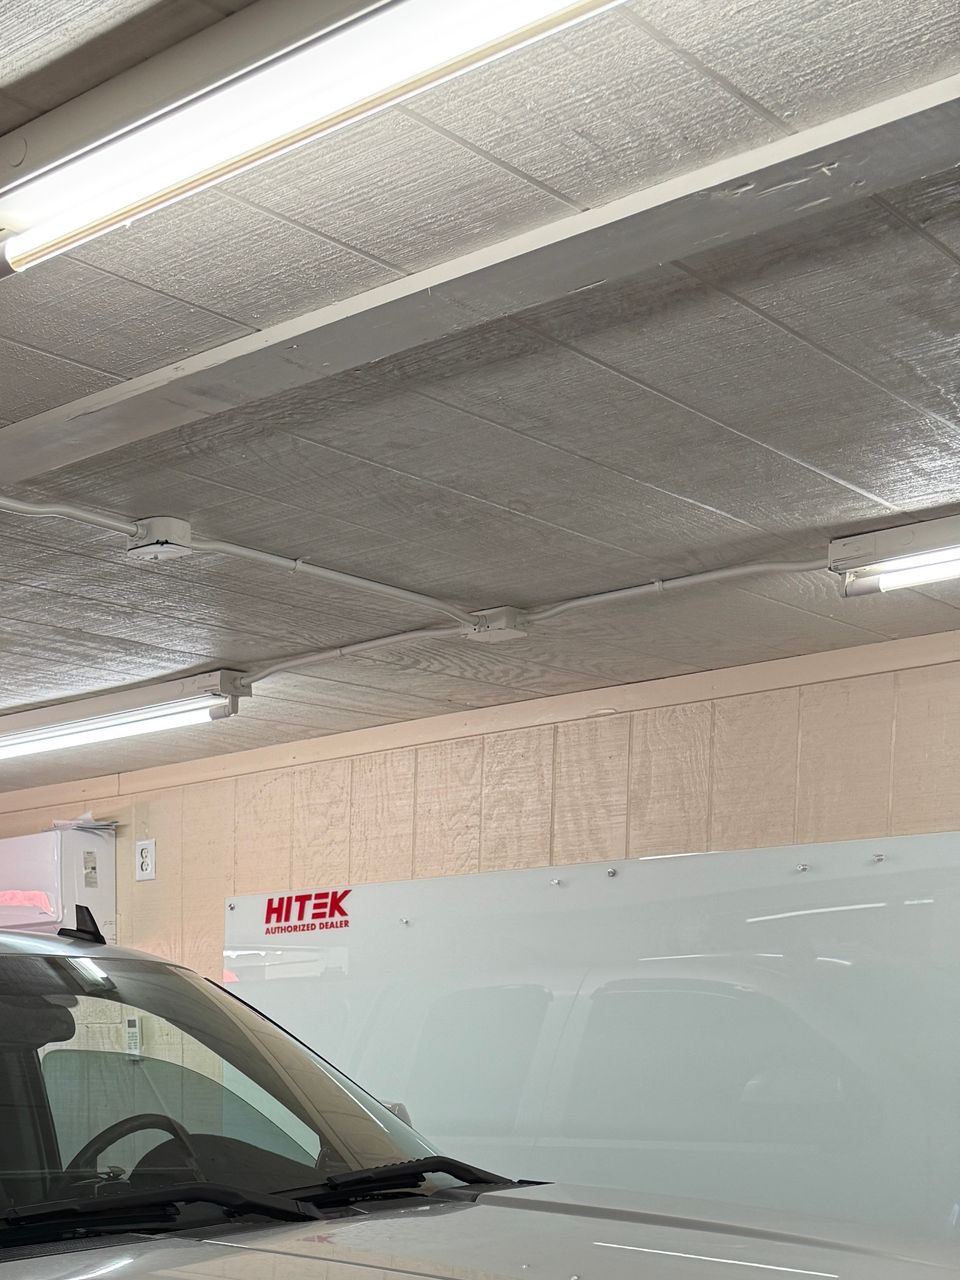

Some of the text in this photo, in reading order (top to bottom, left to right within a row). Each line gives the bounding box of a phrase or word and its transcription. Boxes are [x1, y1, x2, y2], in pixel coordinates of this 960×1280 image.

[265, 889, 352, 924] HITEK
[265, 920, 350, 935] AUTHORIZED DEALER
